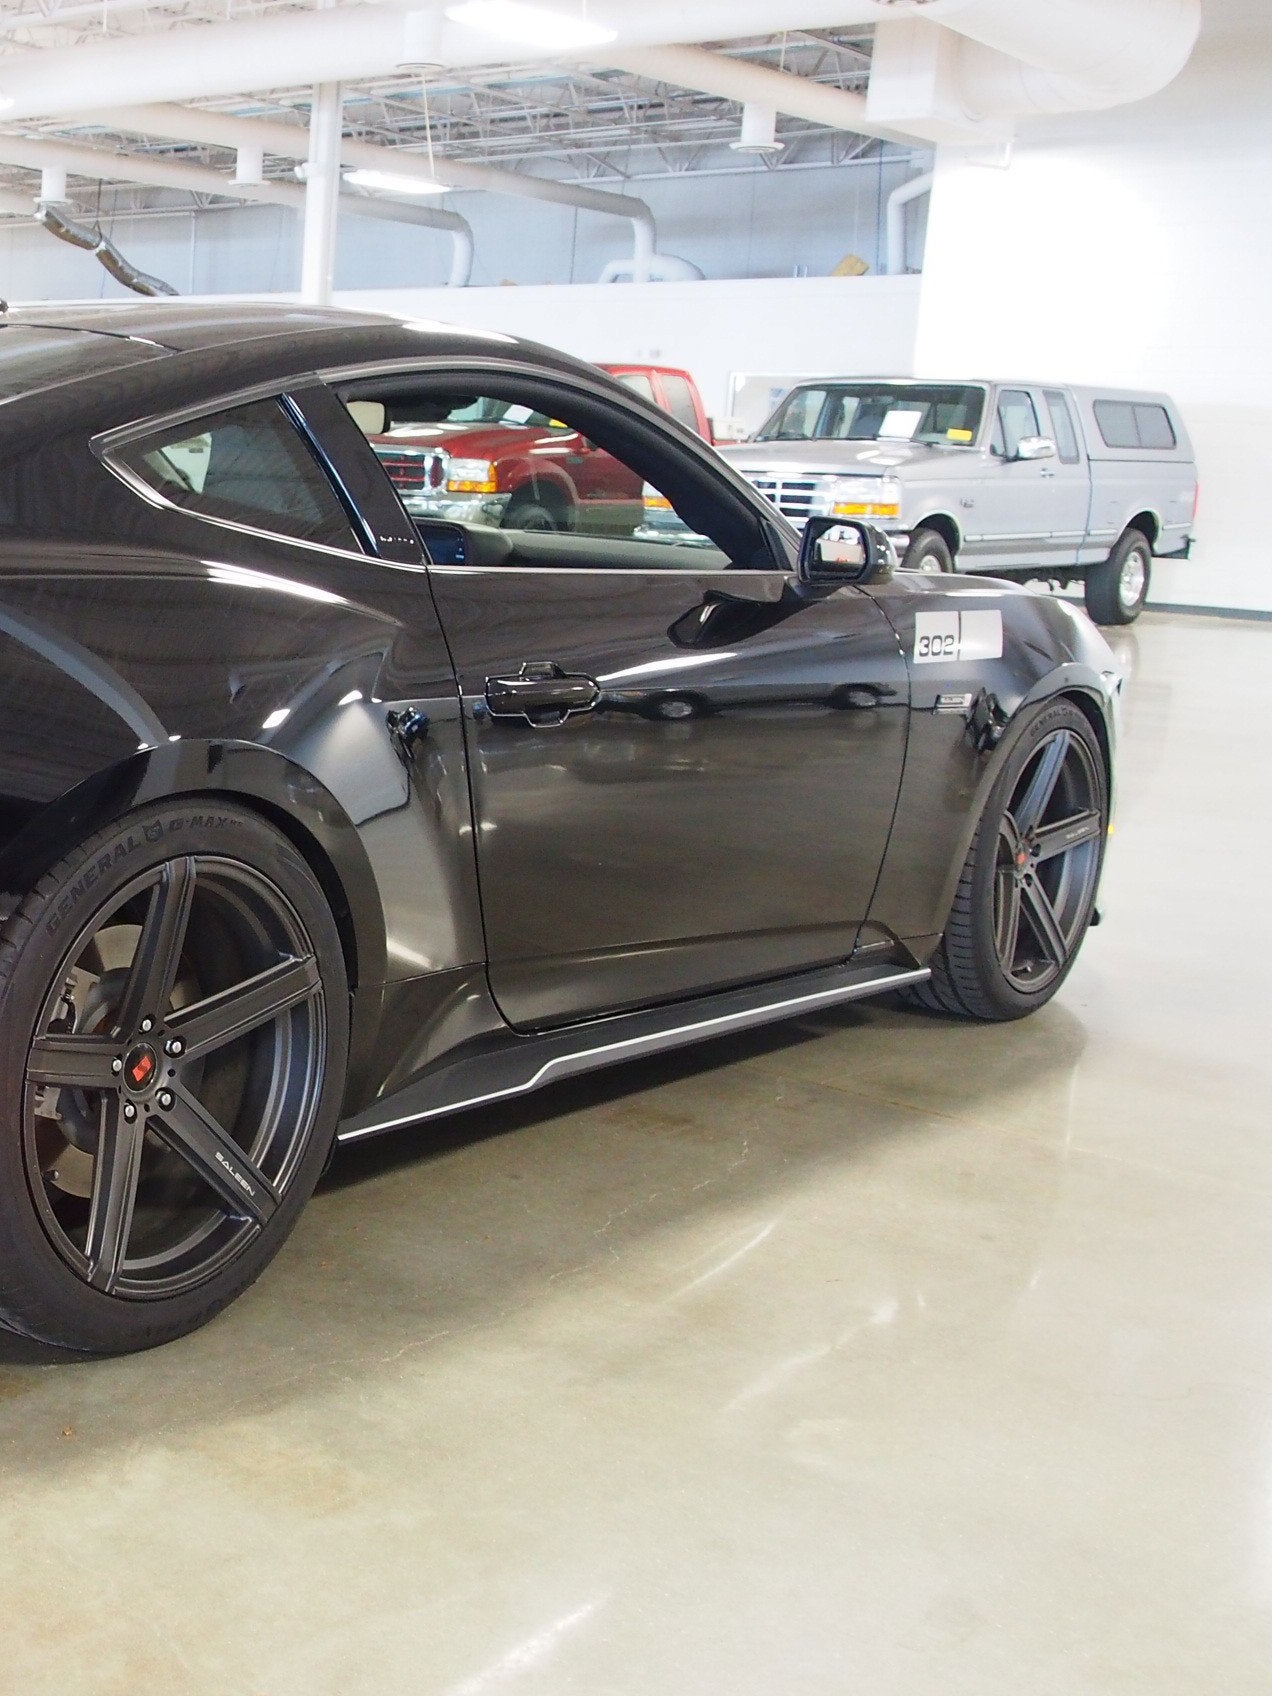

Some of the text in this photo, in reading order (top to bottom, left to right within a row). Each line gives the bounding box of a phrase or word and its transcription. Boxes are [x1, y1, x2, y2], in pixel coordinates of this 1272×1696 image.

[919, 634, 955, 658] 302
[45, 836, 142, 936] GENERAL
[214, 1151, 256, 1197] SALEEN
